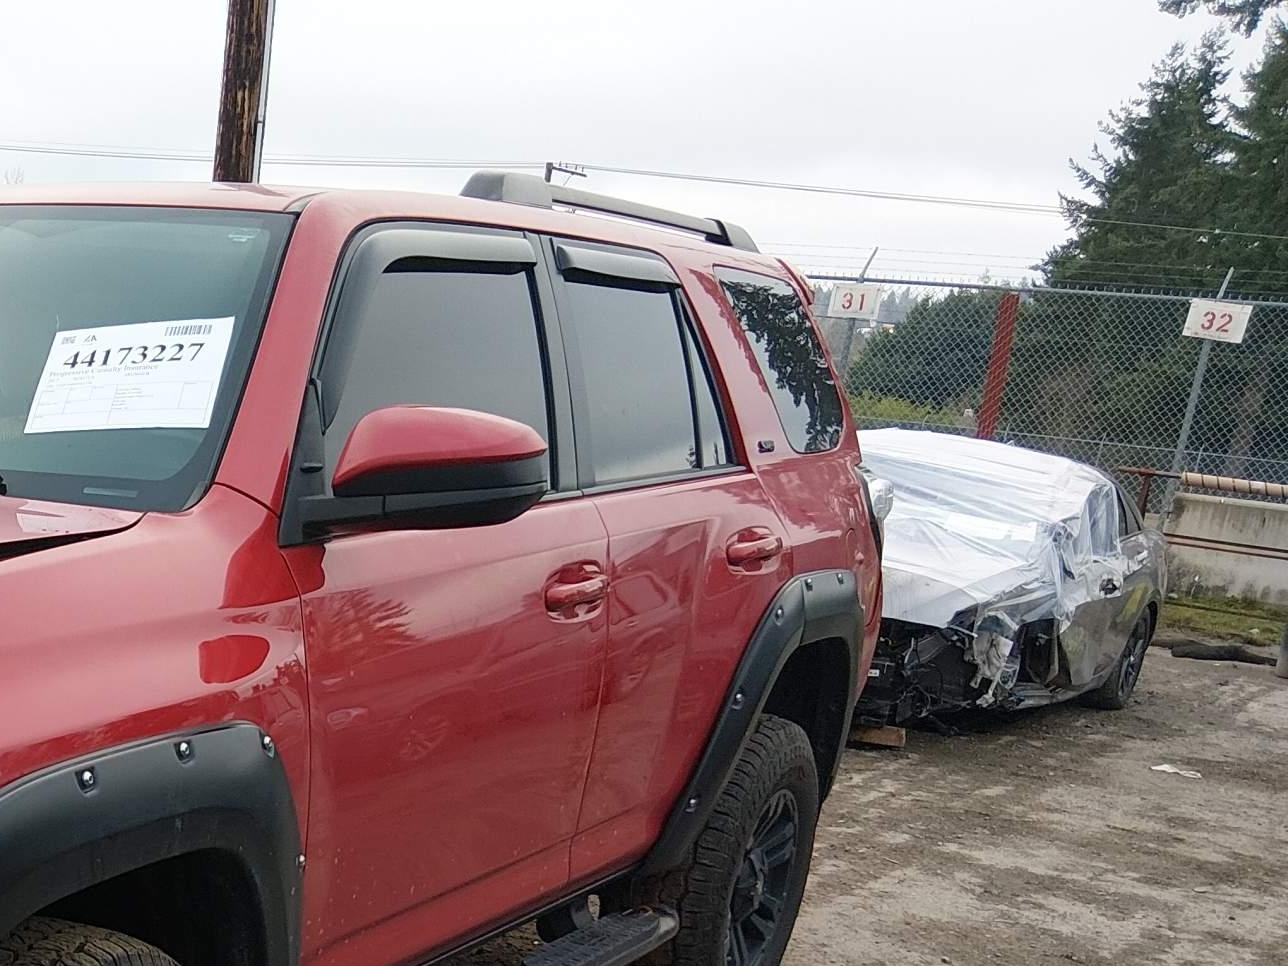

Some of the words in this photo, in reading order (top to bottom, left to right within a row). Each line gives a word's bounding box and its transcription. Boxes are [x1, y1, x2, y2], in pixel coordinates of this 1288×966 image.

[842, 292, 865, 311] 31
[1201, 311, 1232, 332] 32
[63, 342, 206, 369] 44173227
